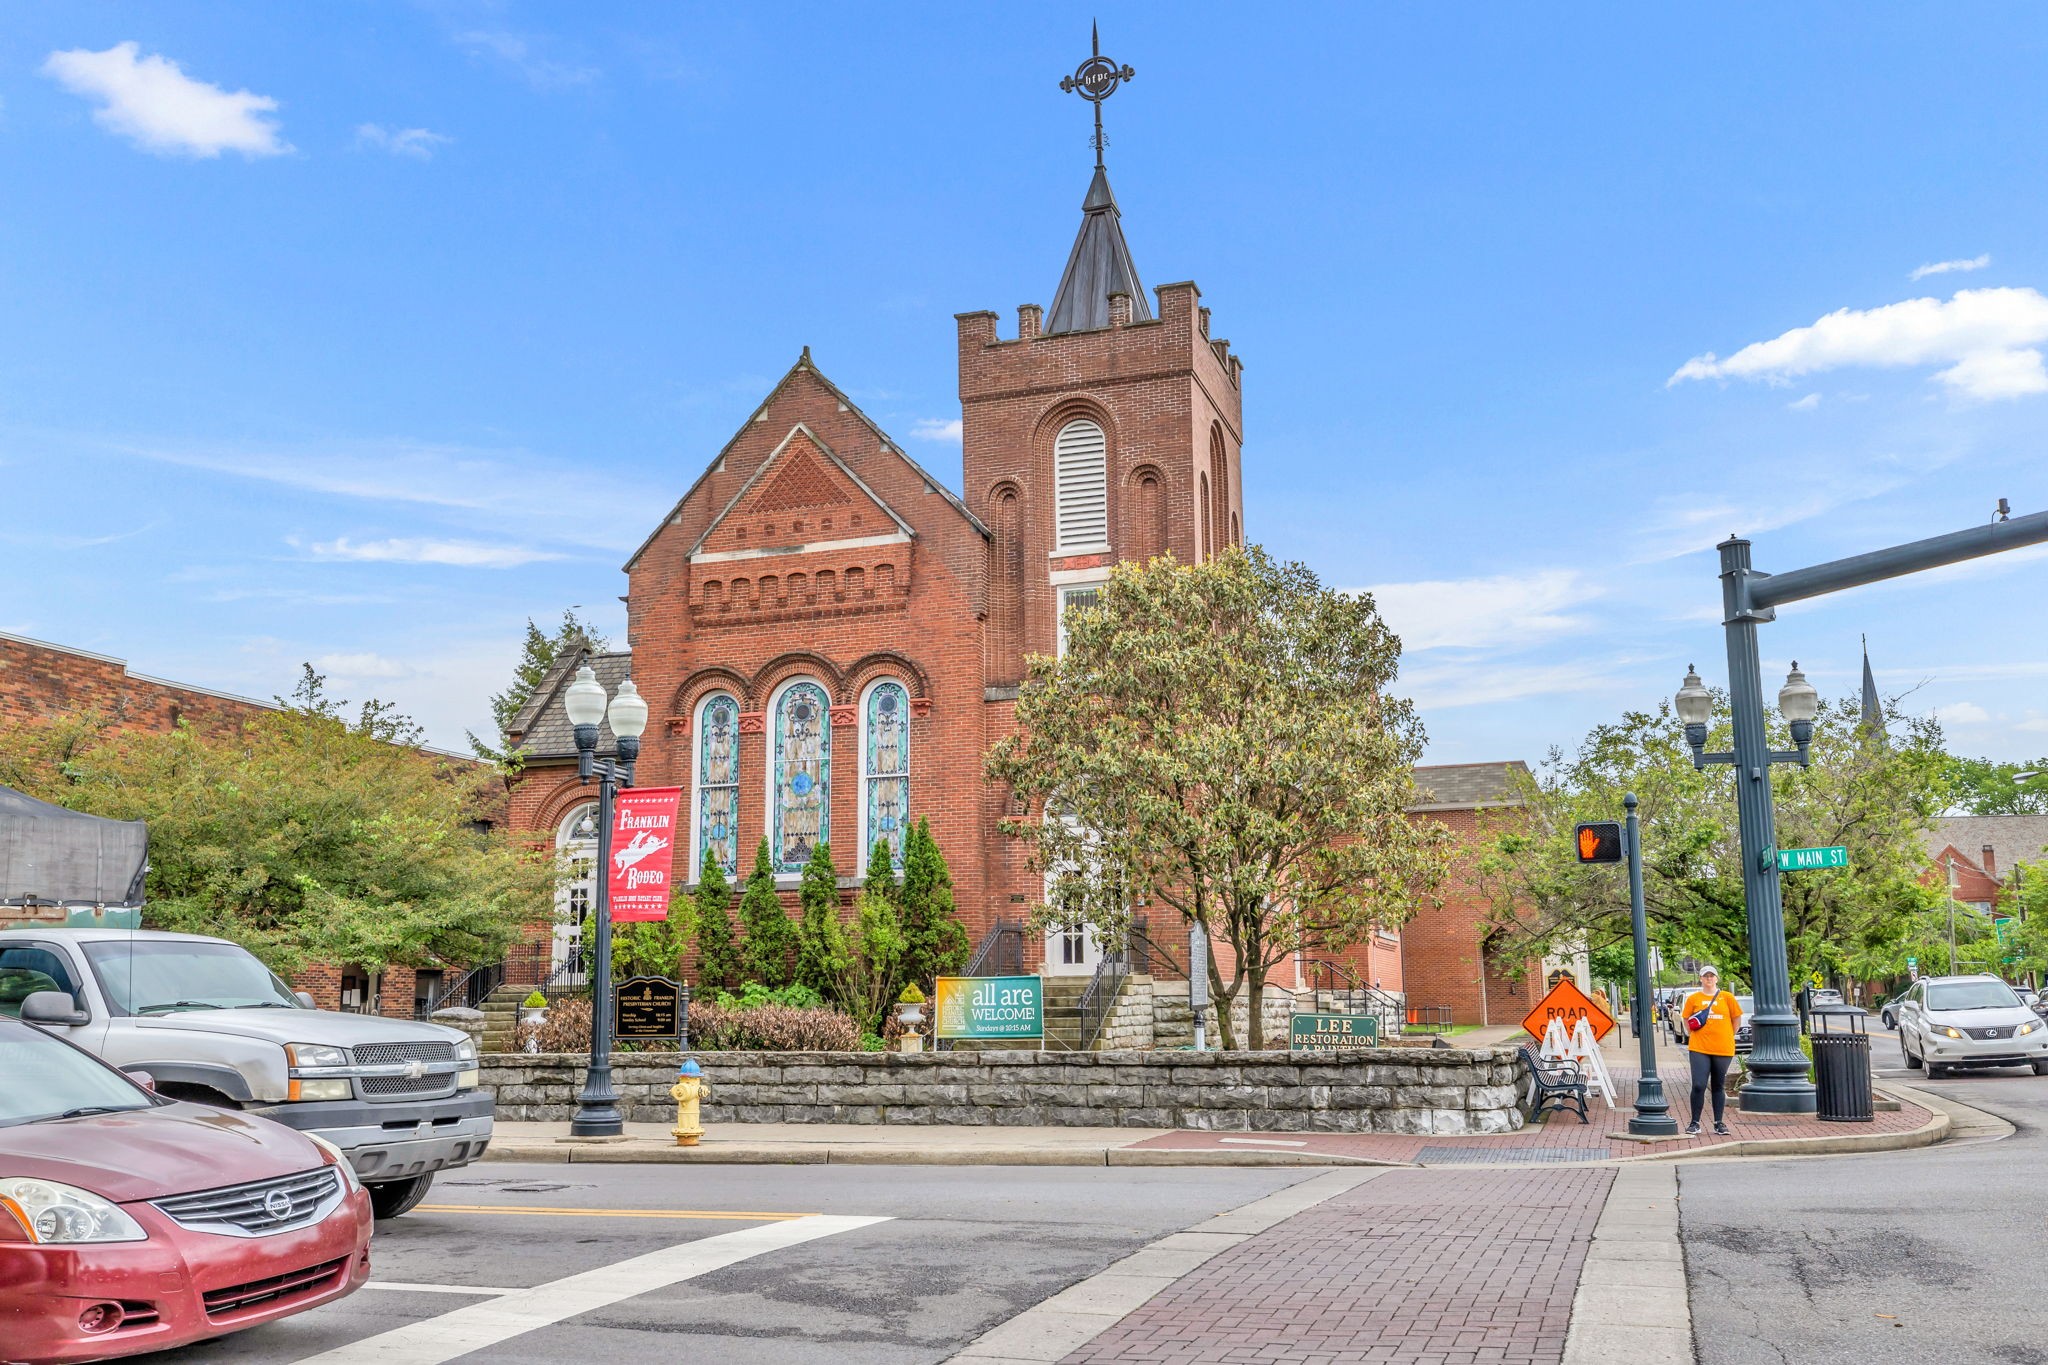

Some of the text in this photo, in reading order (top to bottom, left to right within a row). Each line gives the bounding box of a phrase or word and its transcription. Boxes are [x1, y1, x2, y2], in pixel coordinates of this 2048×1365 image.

[619, 810, 670, 830] FRANKLIN
[1780, 852, 1789, 867] W
[1797, 850, 1823, 866] MAIN
[1830, 849, 1843, 864] ST
[626, 867, 663, 889] RODEO
[972, 983, 1032, 1006] all are
[970, 1007, 1035, 1021] WELCOME!
[1547, 1007, 1587, 1022] ROAD
[976, 1024, 998, 1032] Sundays
[1316, 1019, 1353, 1034] LEE
[1294, 1034, 1374, 1046] RESTORATION
